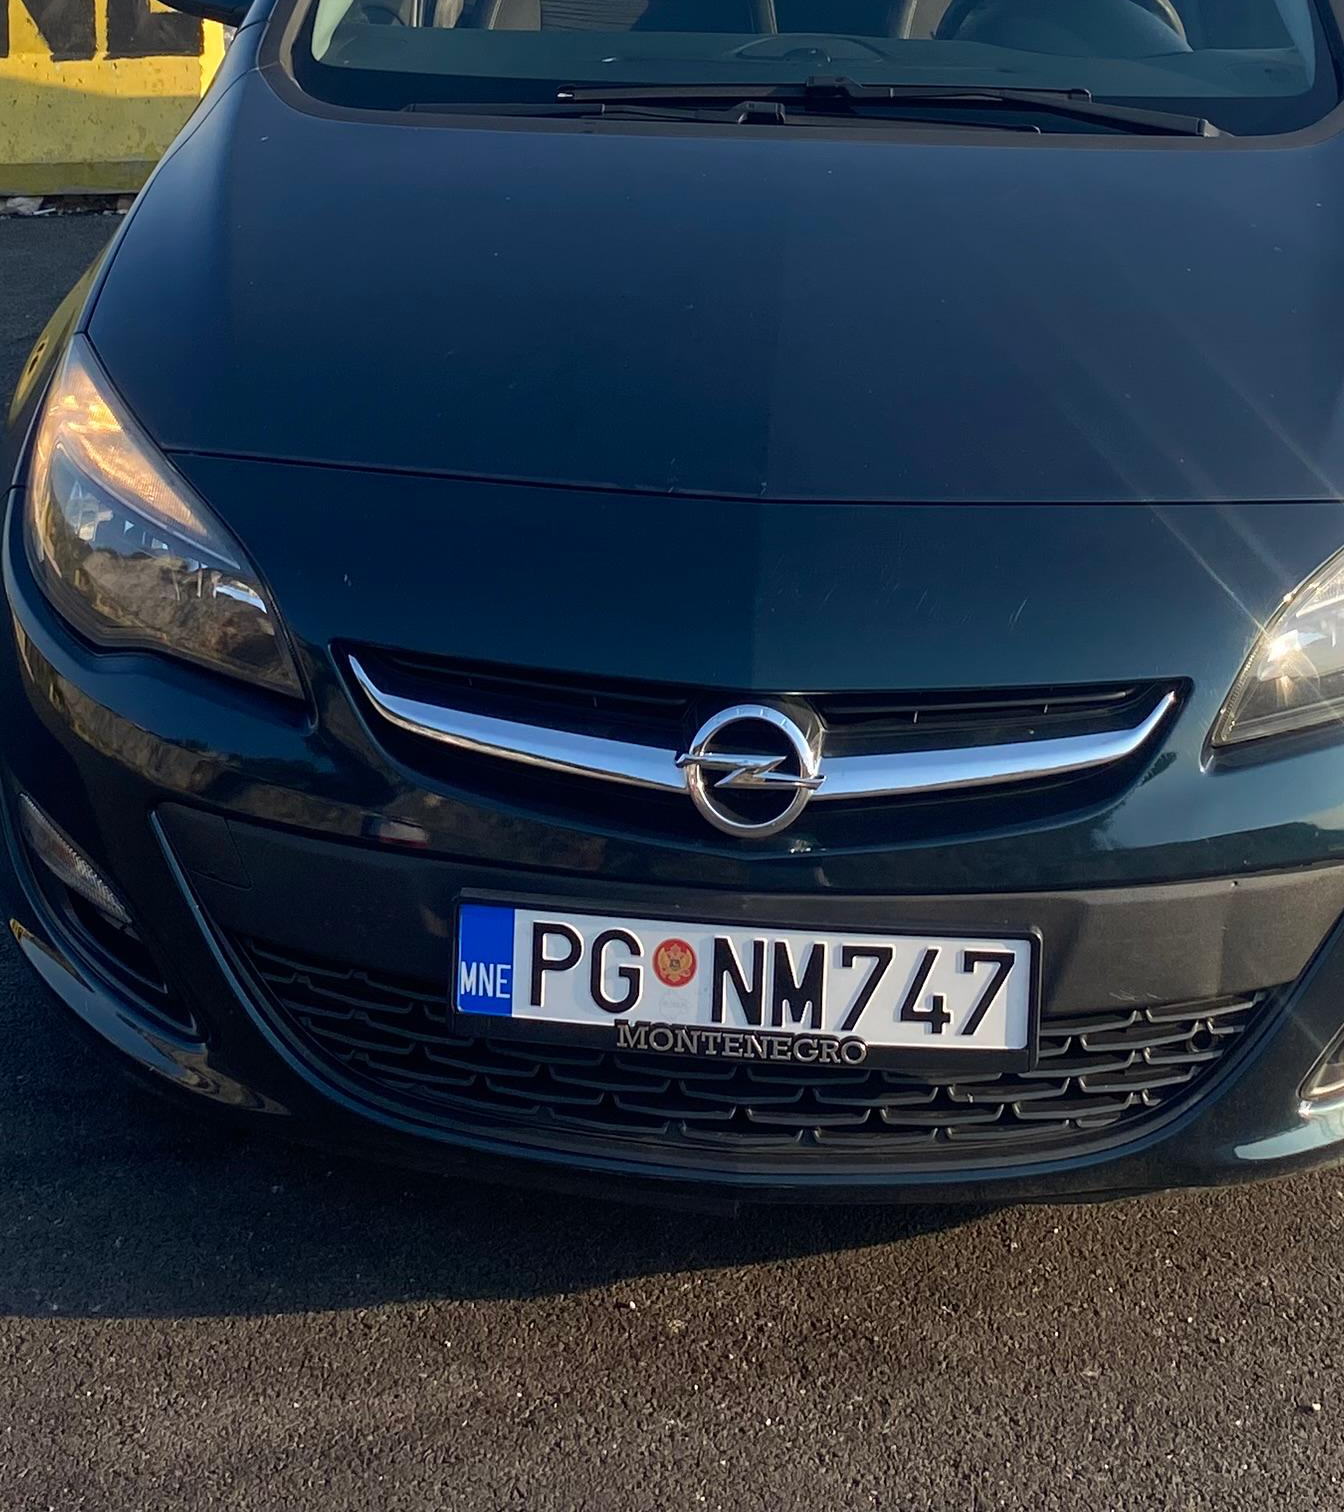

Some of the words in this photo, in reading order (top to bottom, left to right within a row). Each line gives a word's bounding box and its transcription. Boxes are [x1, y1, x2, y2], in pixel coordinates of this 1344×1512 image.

[460, 961, 512, 999] MNE
[530, 921, 642, 1014] PG
[711, 936, 1016, 1036] NM747
[616, 1023, 868, 1065] MONTENEGRO
